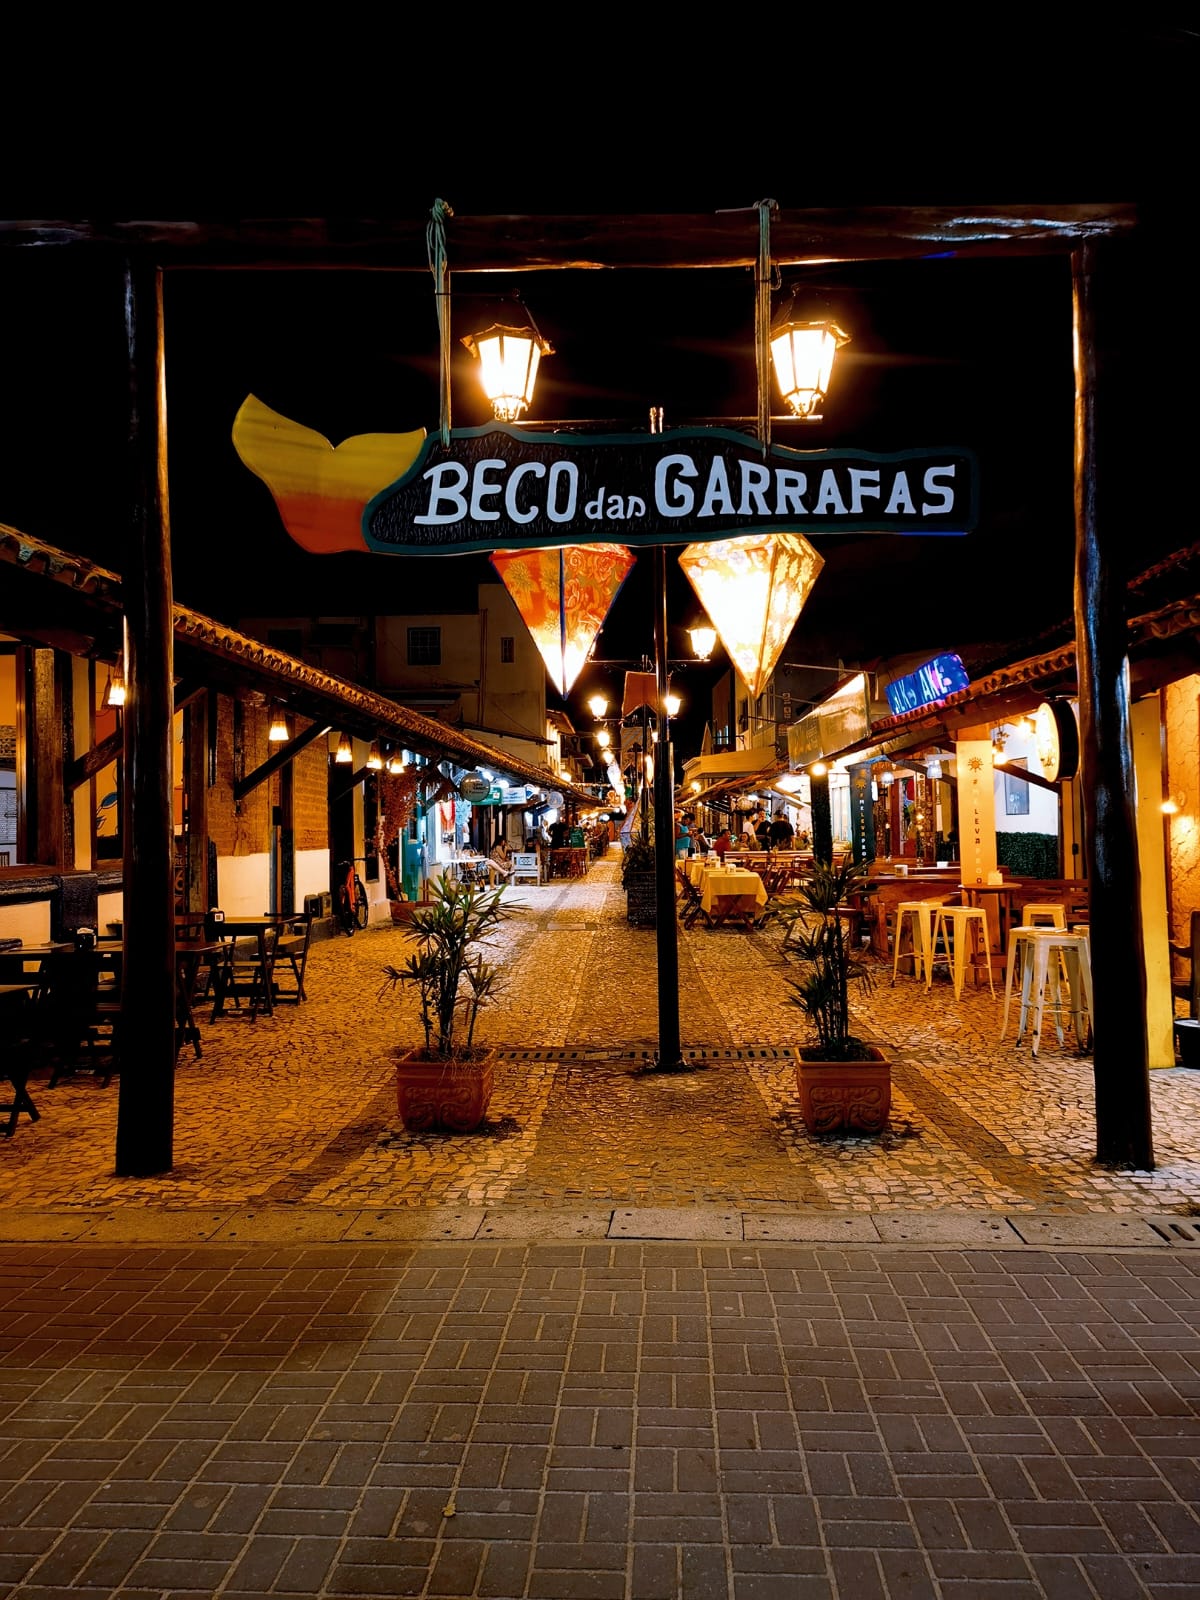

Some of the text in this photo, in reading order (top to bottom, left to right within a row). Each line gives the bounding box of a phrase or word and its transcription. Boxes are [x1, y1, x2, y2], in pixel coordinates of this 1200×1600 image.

[413, 453, 956, 525] BECO das GARRAFAS
